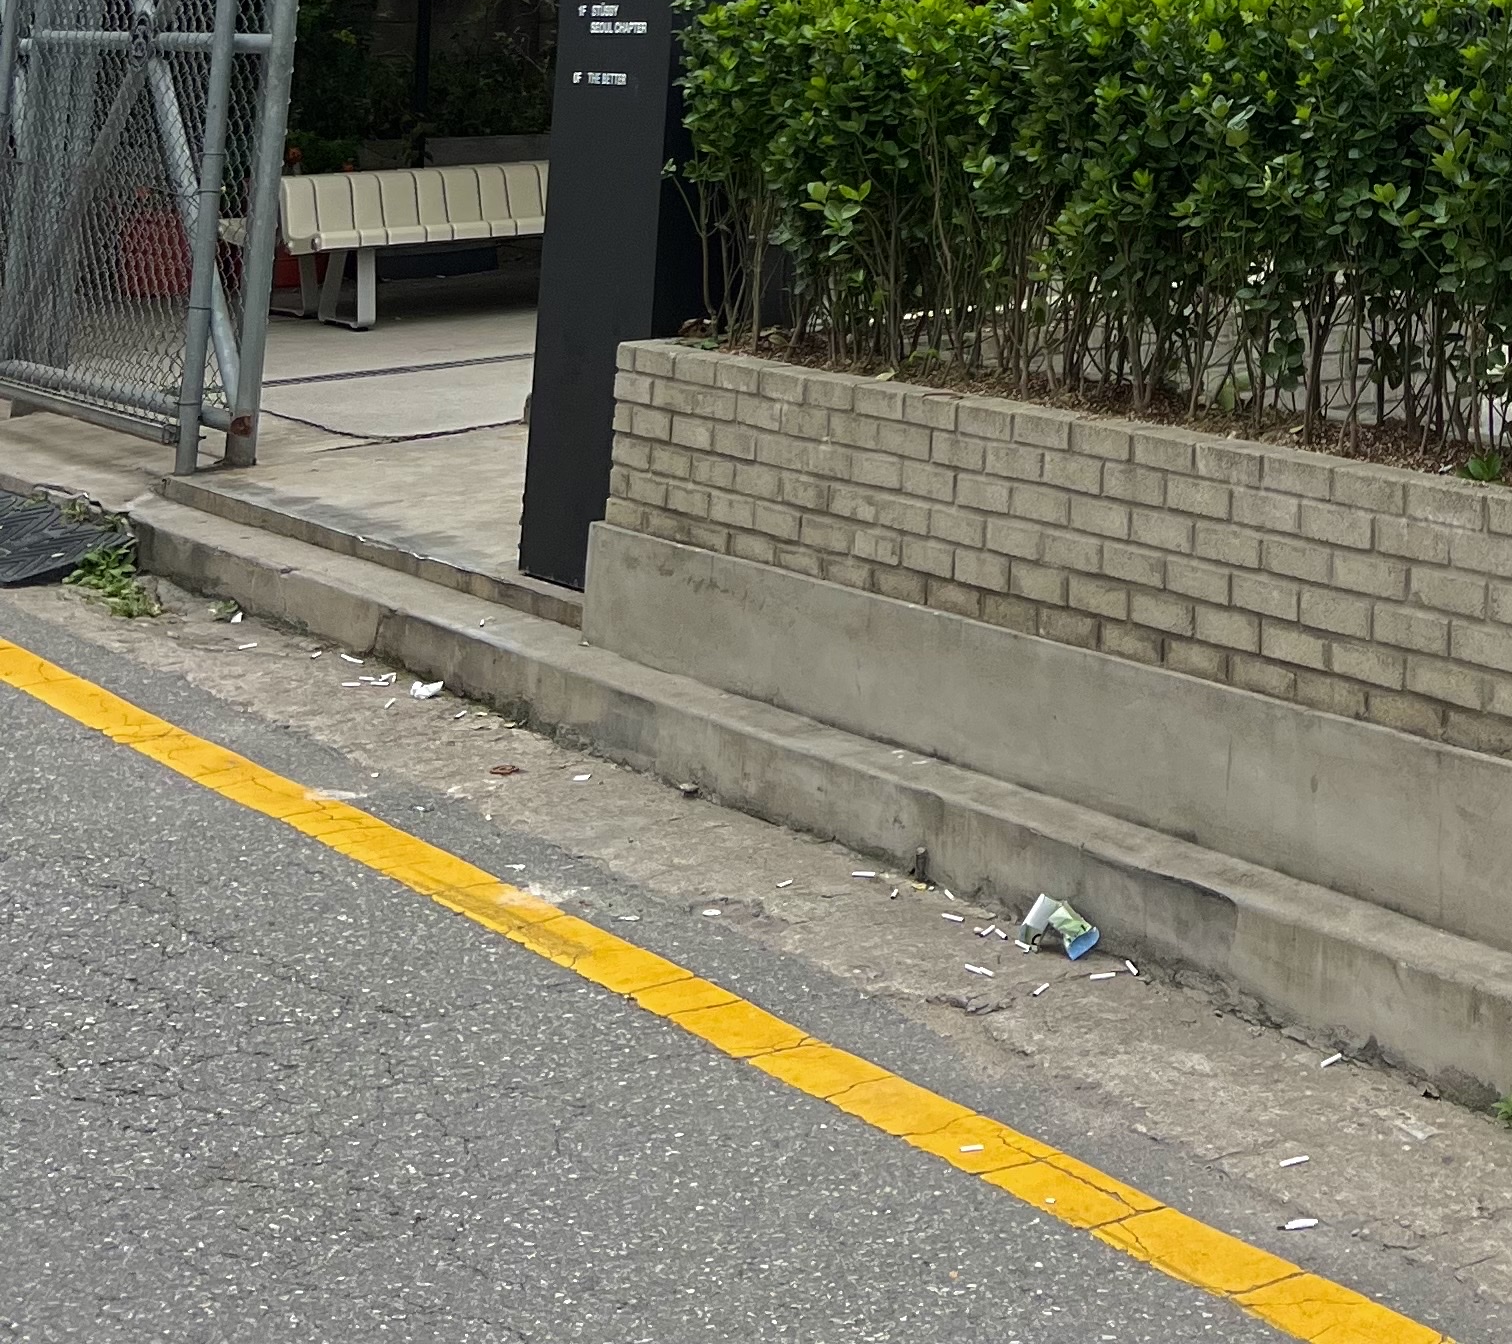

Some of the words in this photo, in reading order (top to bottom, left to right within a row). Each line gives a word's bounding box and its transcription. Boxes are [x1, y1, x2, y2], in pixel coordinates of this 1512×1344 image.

[578, 5, 587, 16] 1F
[588, 72, 601, 84] THE
[602, 73, 627, 85] BETTER
